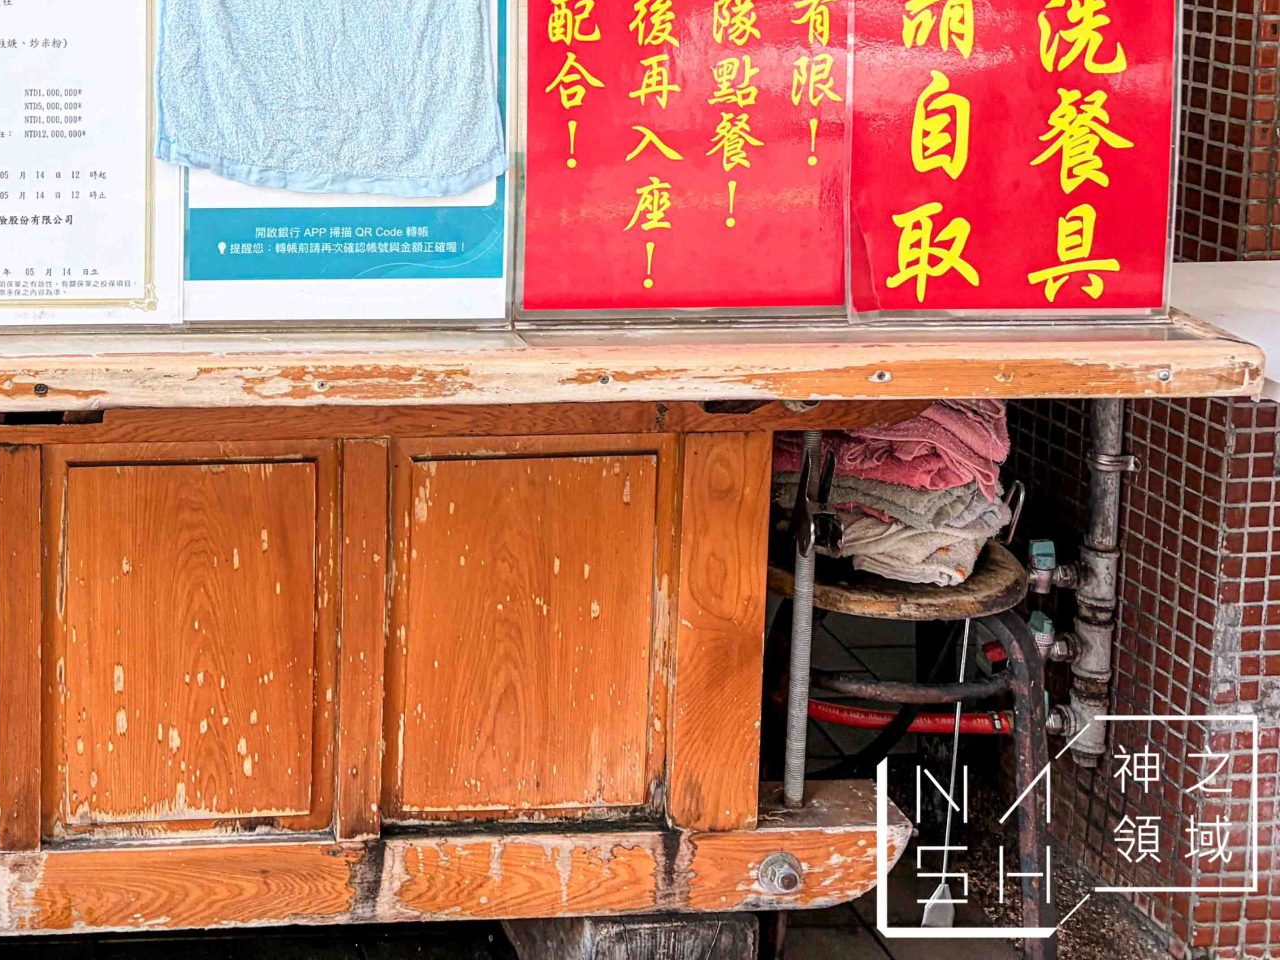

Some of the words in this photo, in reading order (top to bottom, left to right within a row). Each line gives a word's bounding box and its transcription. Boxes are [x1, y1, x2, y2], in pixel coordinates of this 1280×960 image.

[0, 171, 9, 179] 05
[0, 191, 9, 199] 05
[256, 226, 300, 238] 開啟銀行
[304, 228, 326, 237] APP
[330, 226, 352, 238] 掃描
[355, 227, 373, 237] QR
[376, 227, 403, 237] Code
[406, 226, 429, 237] 轉帳
